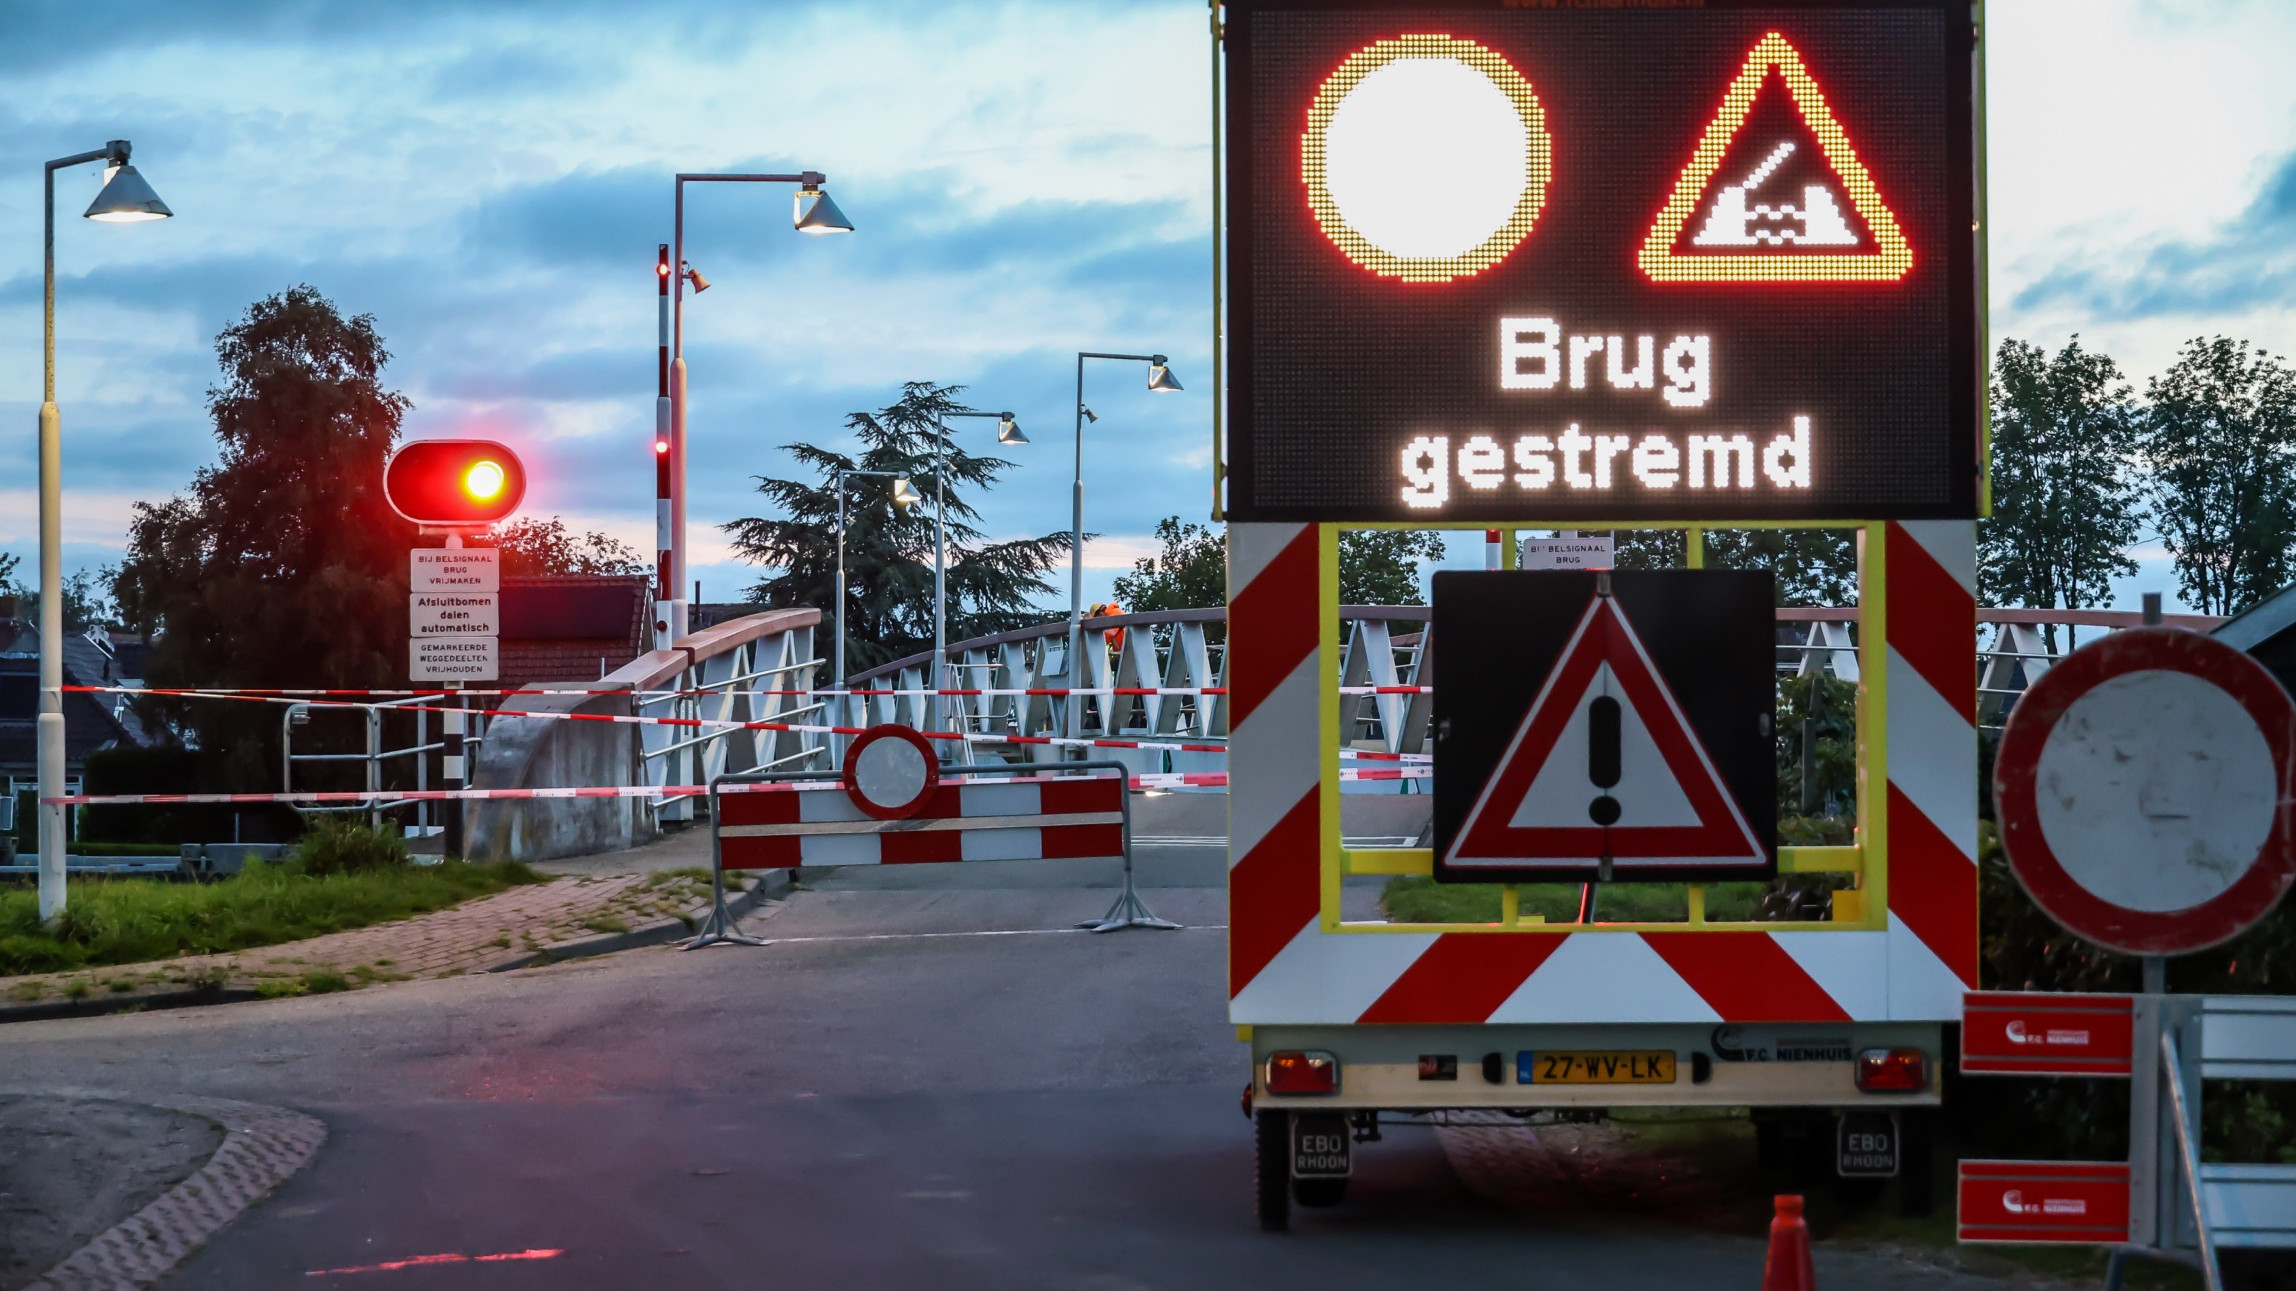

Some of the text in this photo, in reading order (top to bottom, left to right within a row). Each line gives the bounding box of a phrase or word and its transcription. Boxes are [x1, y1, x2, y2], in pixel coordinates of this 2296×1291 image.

[1499, 317, 1711, 407] Brug
[1400, 415, 1812, 508] gestremd
[418, 555, 493, 563] BIJ BELSIGNAAL
[443, 566, 468, 574] BRUG
[418, 597, 492, 607] Afsluitbomen
[440, 610, 470, 619] dalen
[421, 623, 490, 633] automatisch
[1776, 1047, 1852, 1061] NIENHUIS
[1543, 1055, 1663, 1079] 27-WV-LK
[1302, 1135, 1341, 1152] EBO
[1848, 1133, 1888, 1151] EBO
[1297, 1155, 1347, 1168] RHOON
[1843, 1153, 1894, 1168] RHOON
